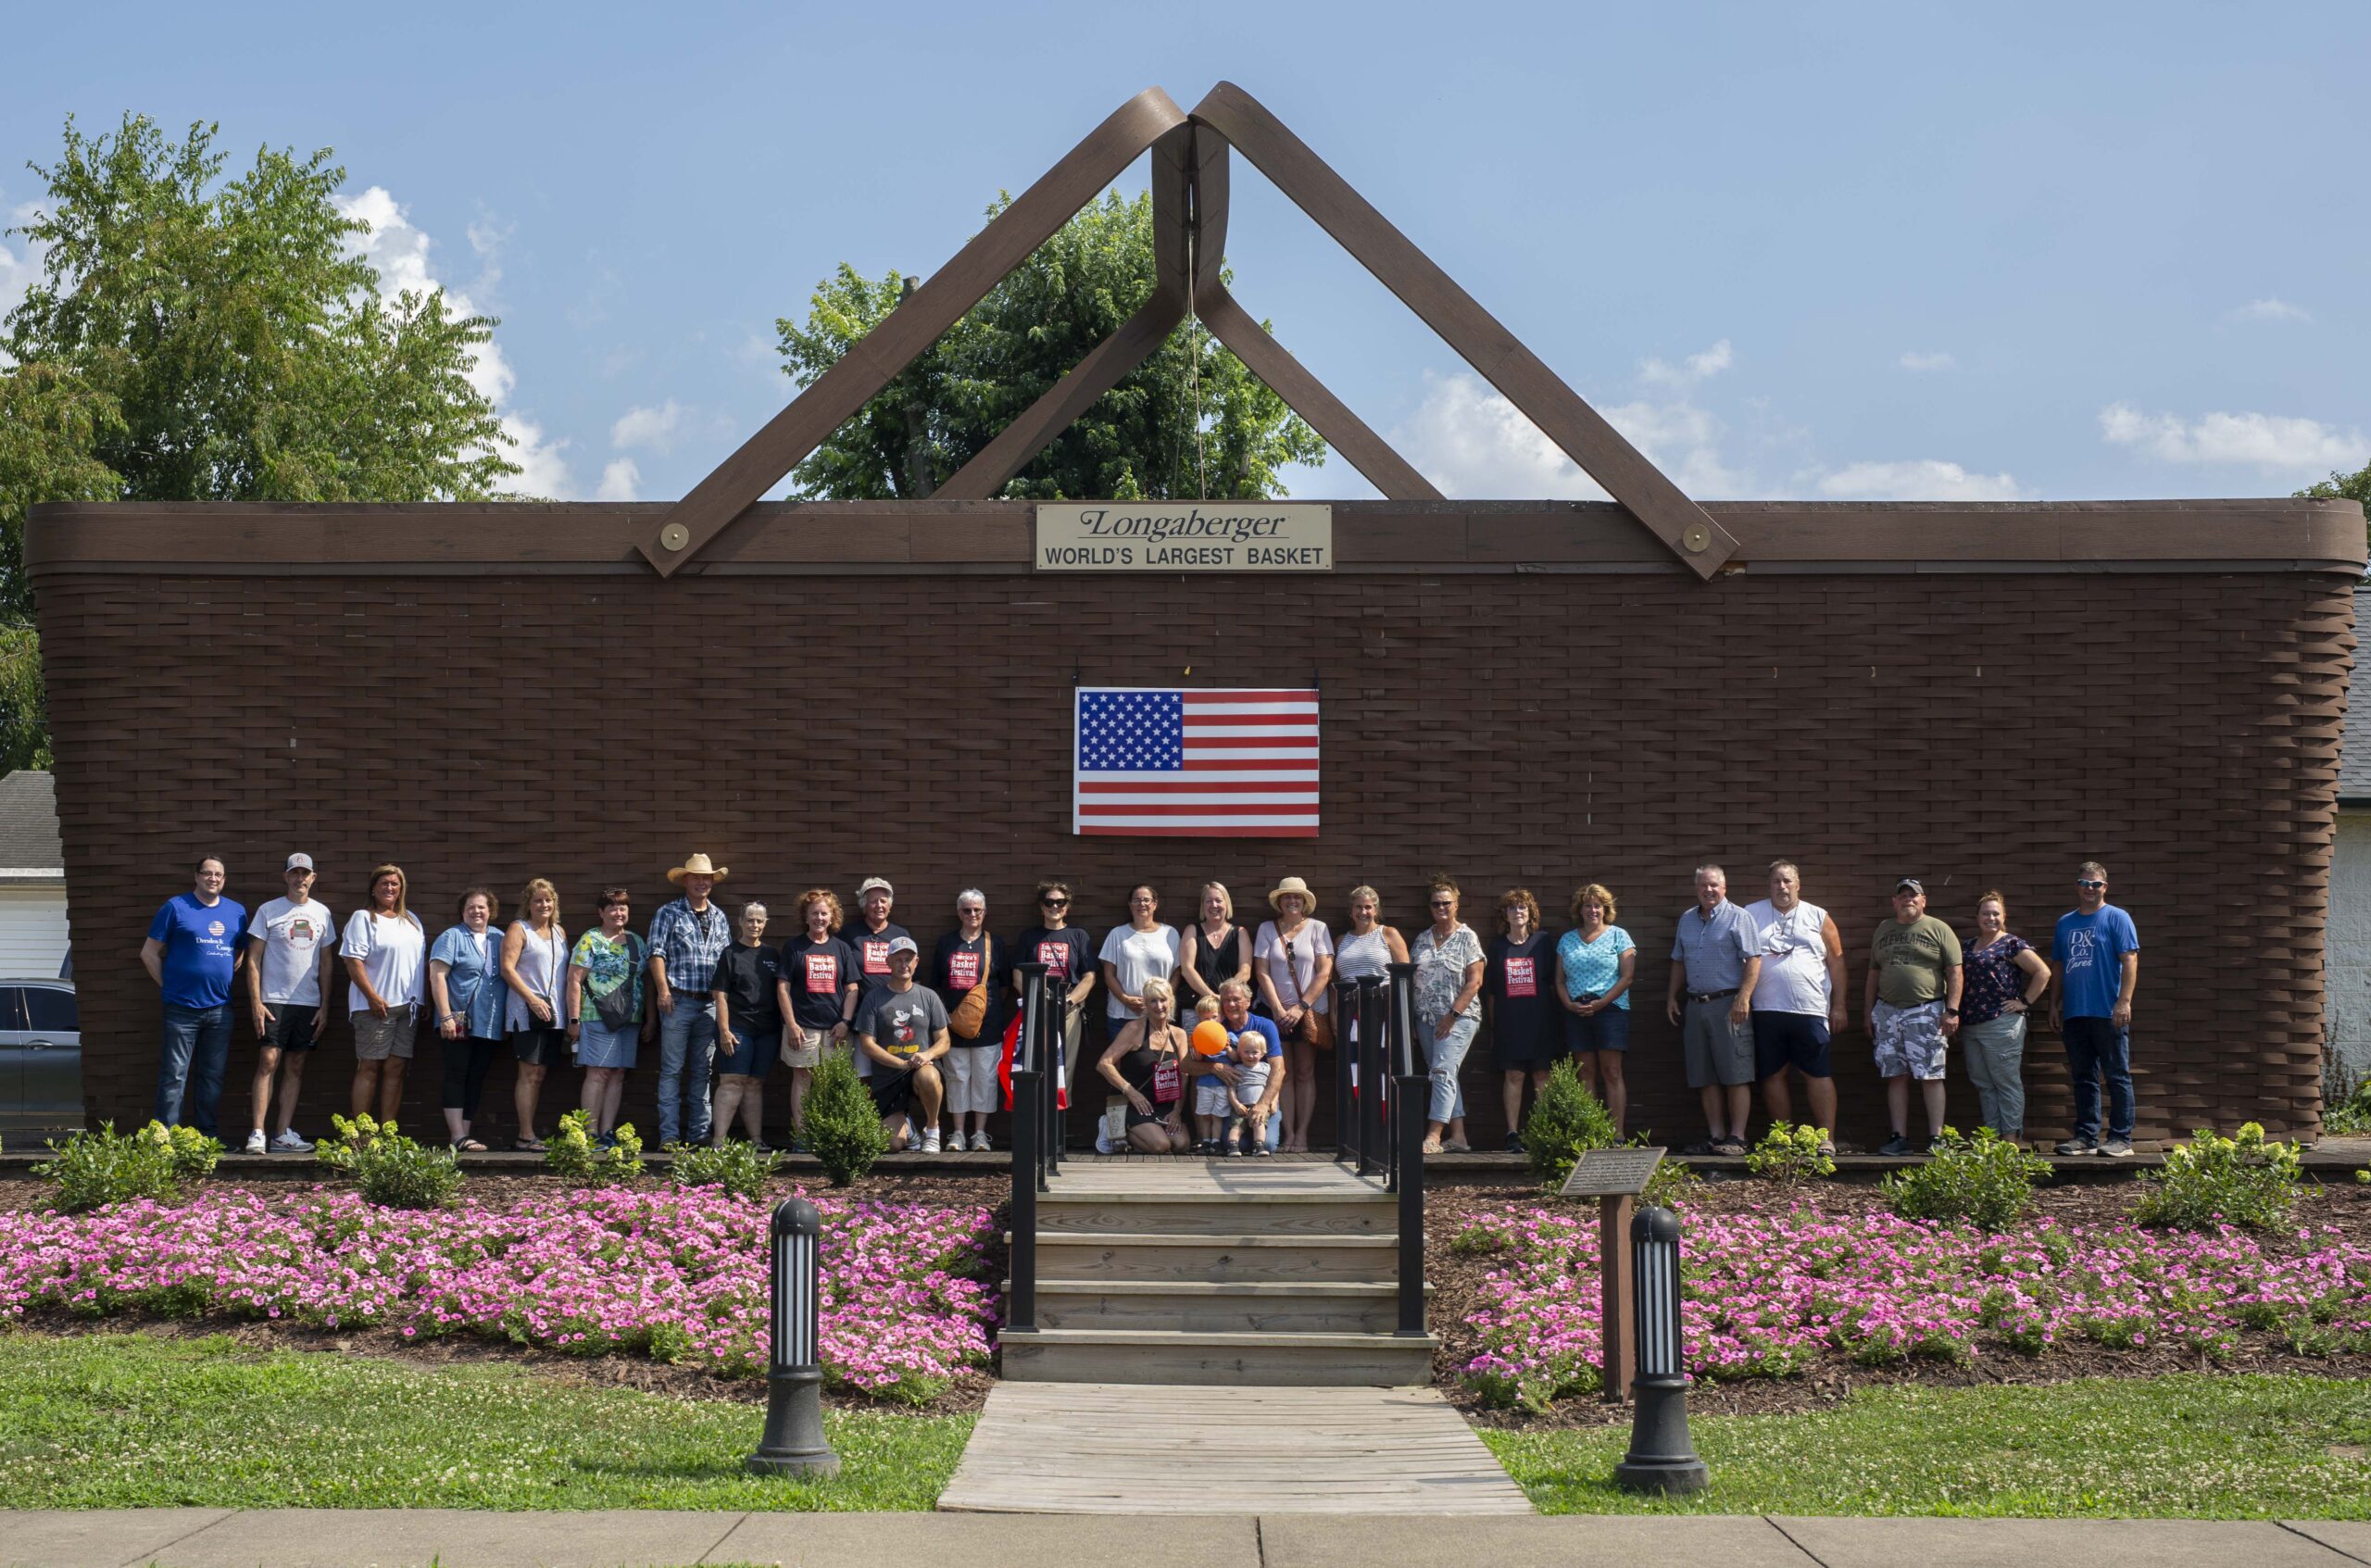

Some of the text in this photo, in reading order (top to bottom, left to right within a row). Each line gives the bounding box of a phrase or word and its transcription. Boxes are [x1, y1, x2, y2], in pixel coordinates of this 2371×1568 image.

[1080, 509, 1286, 543] Longaberger
[1045, 547, 1323, 565] WORLD'S LARGEST BASKET
[2071, 944, 2089, 957] Co.
[809, 961, 834, 971] Basket
[951, 960, 976, 969] Basket
[2066, 958, 2093, 973] Cares
[809, 971, 834, 979] Festival
[950, 968, 976, 977] Festival
[1508, 966, 1533, 975] Basket
[1509, 975, 1534, 985] Festival
[1155, 1070, 1178, 1082] Basket
[1156, 1079, 1179, 1090] Festival
